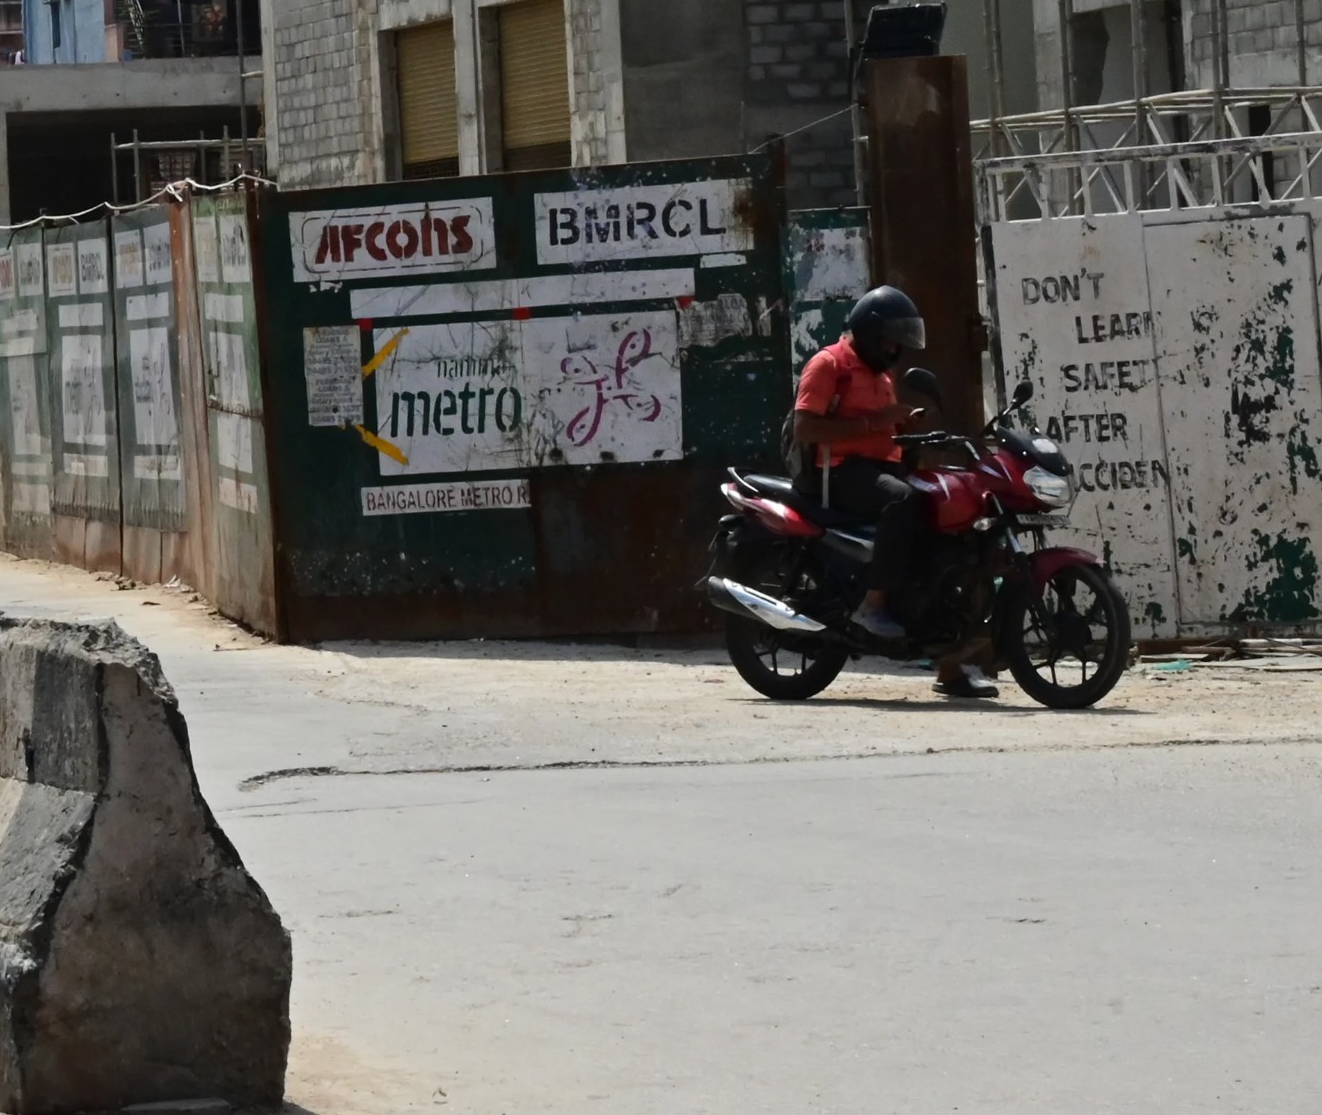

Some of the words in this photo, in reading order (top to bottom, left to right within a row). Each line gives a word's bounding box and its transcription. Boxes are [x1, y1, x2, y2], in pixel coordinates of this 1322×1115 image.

[314, 213, 474, 264] AFCONS
[549, 199, 727, 246] BMRCL
[1021, 268, 1104, 305] DON'T
[390, 382, 522, 439] metro
[1047, 413, 1129, 444] AFTER
[366, 489, 456, 511] BANGALORE
[461, 486, 513, 507] METRO
